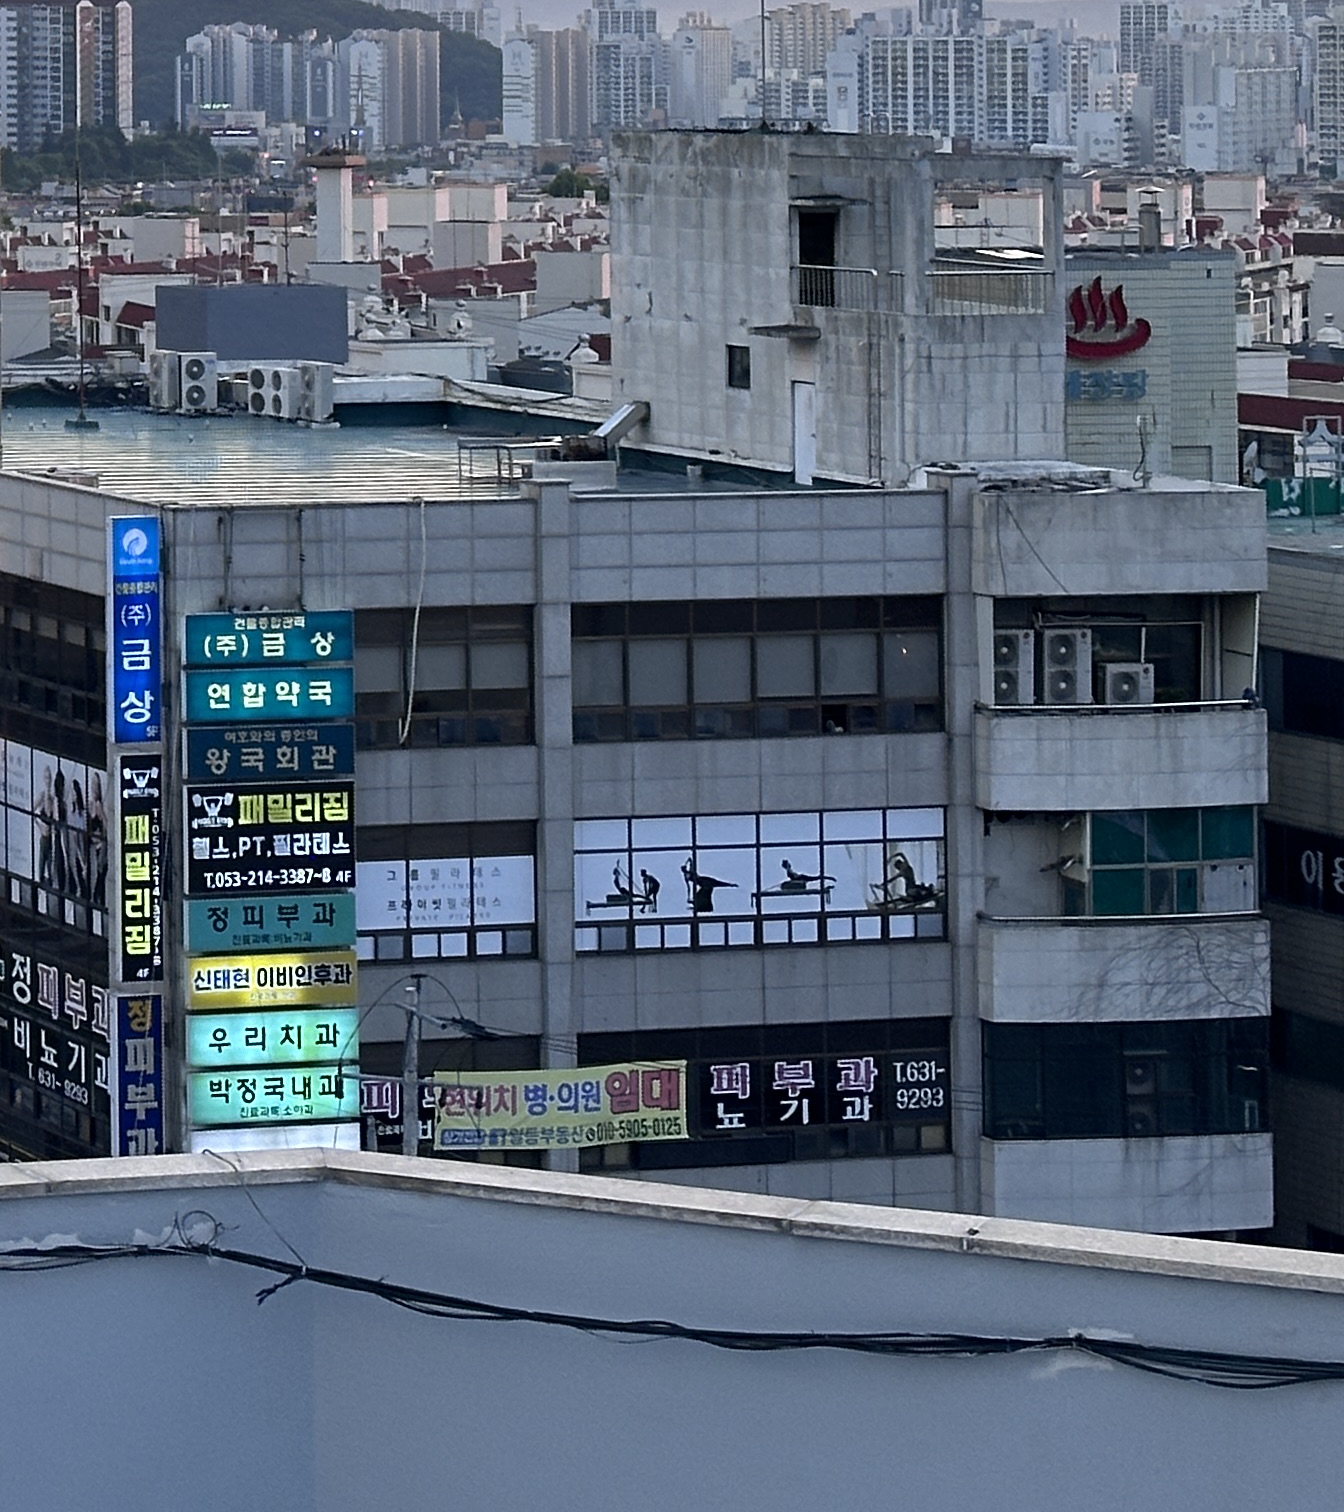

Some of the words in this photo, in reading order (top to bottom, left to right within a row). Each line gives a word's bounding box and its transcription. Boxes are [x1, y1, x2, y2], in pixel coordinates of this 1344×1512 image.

[120, 604, 153, 627] (주)
[204, 633, 249, 658] (주)
[120, 638, 155, 724] 금상
[207, 680, 333, 710] 연합약국
[205, 744, 337, 775] 왕국회관
[238, 791, 349, 825] 패밀리짐
[124, 814, 151, 955] 패밀리짐
[336, 870, 352, 884] 4F
[207, 902, 337, 933] 정피부과
[193, 968, 251, 992] 신태현
[257, 963, 353, 987] 이비인후과
[208, 1022, 341, 1054] 우리치과
[124, 998, 158, 1155] 정피부과
[208, 1074, 341, 1104] 박정국내과
[604, 1067, 682, 1115] 임대
[710, 1057, 878, 1099] 피부과
[896, 1088, 945, 1110] 9293
[596, 1116, 682, 1142] 010-5905-0125
